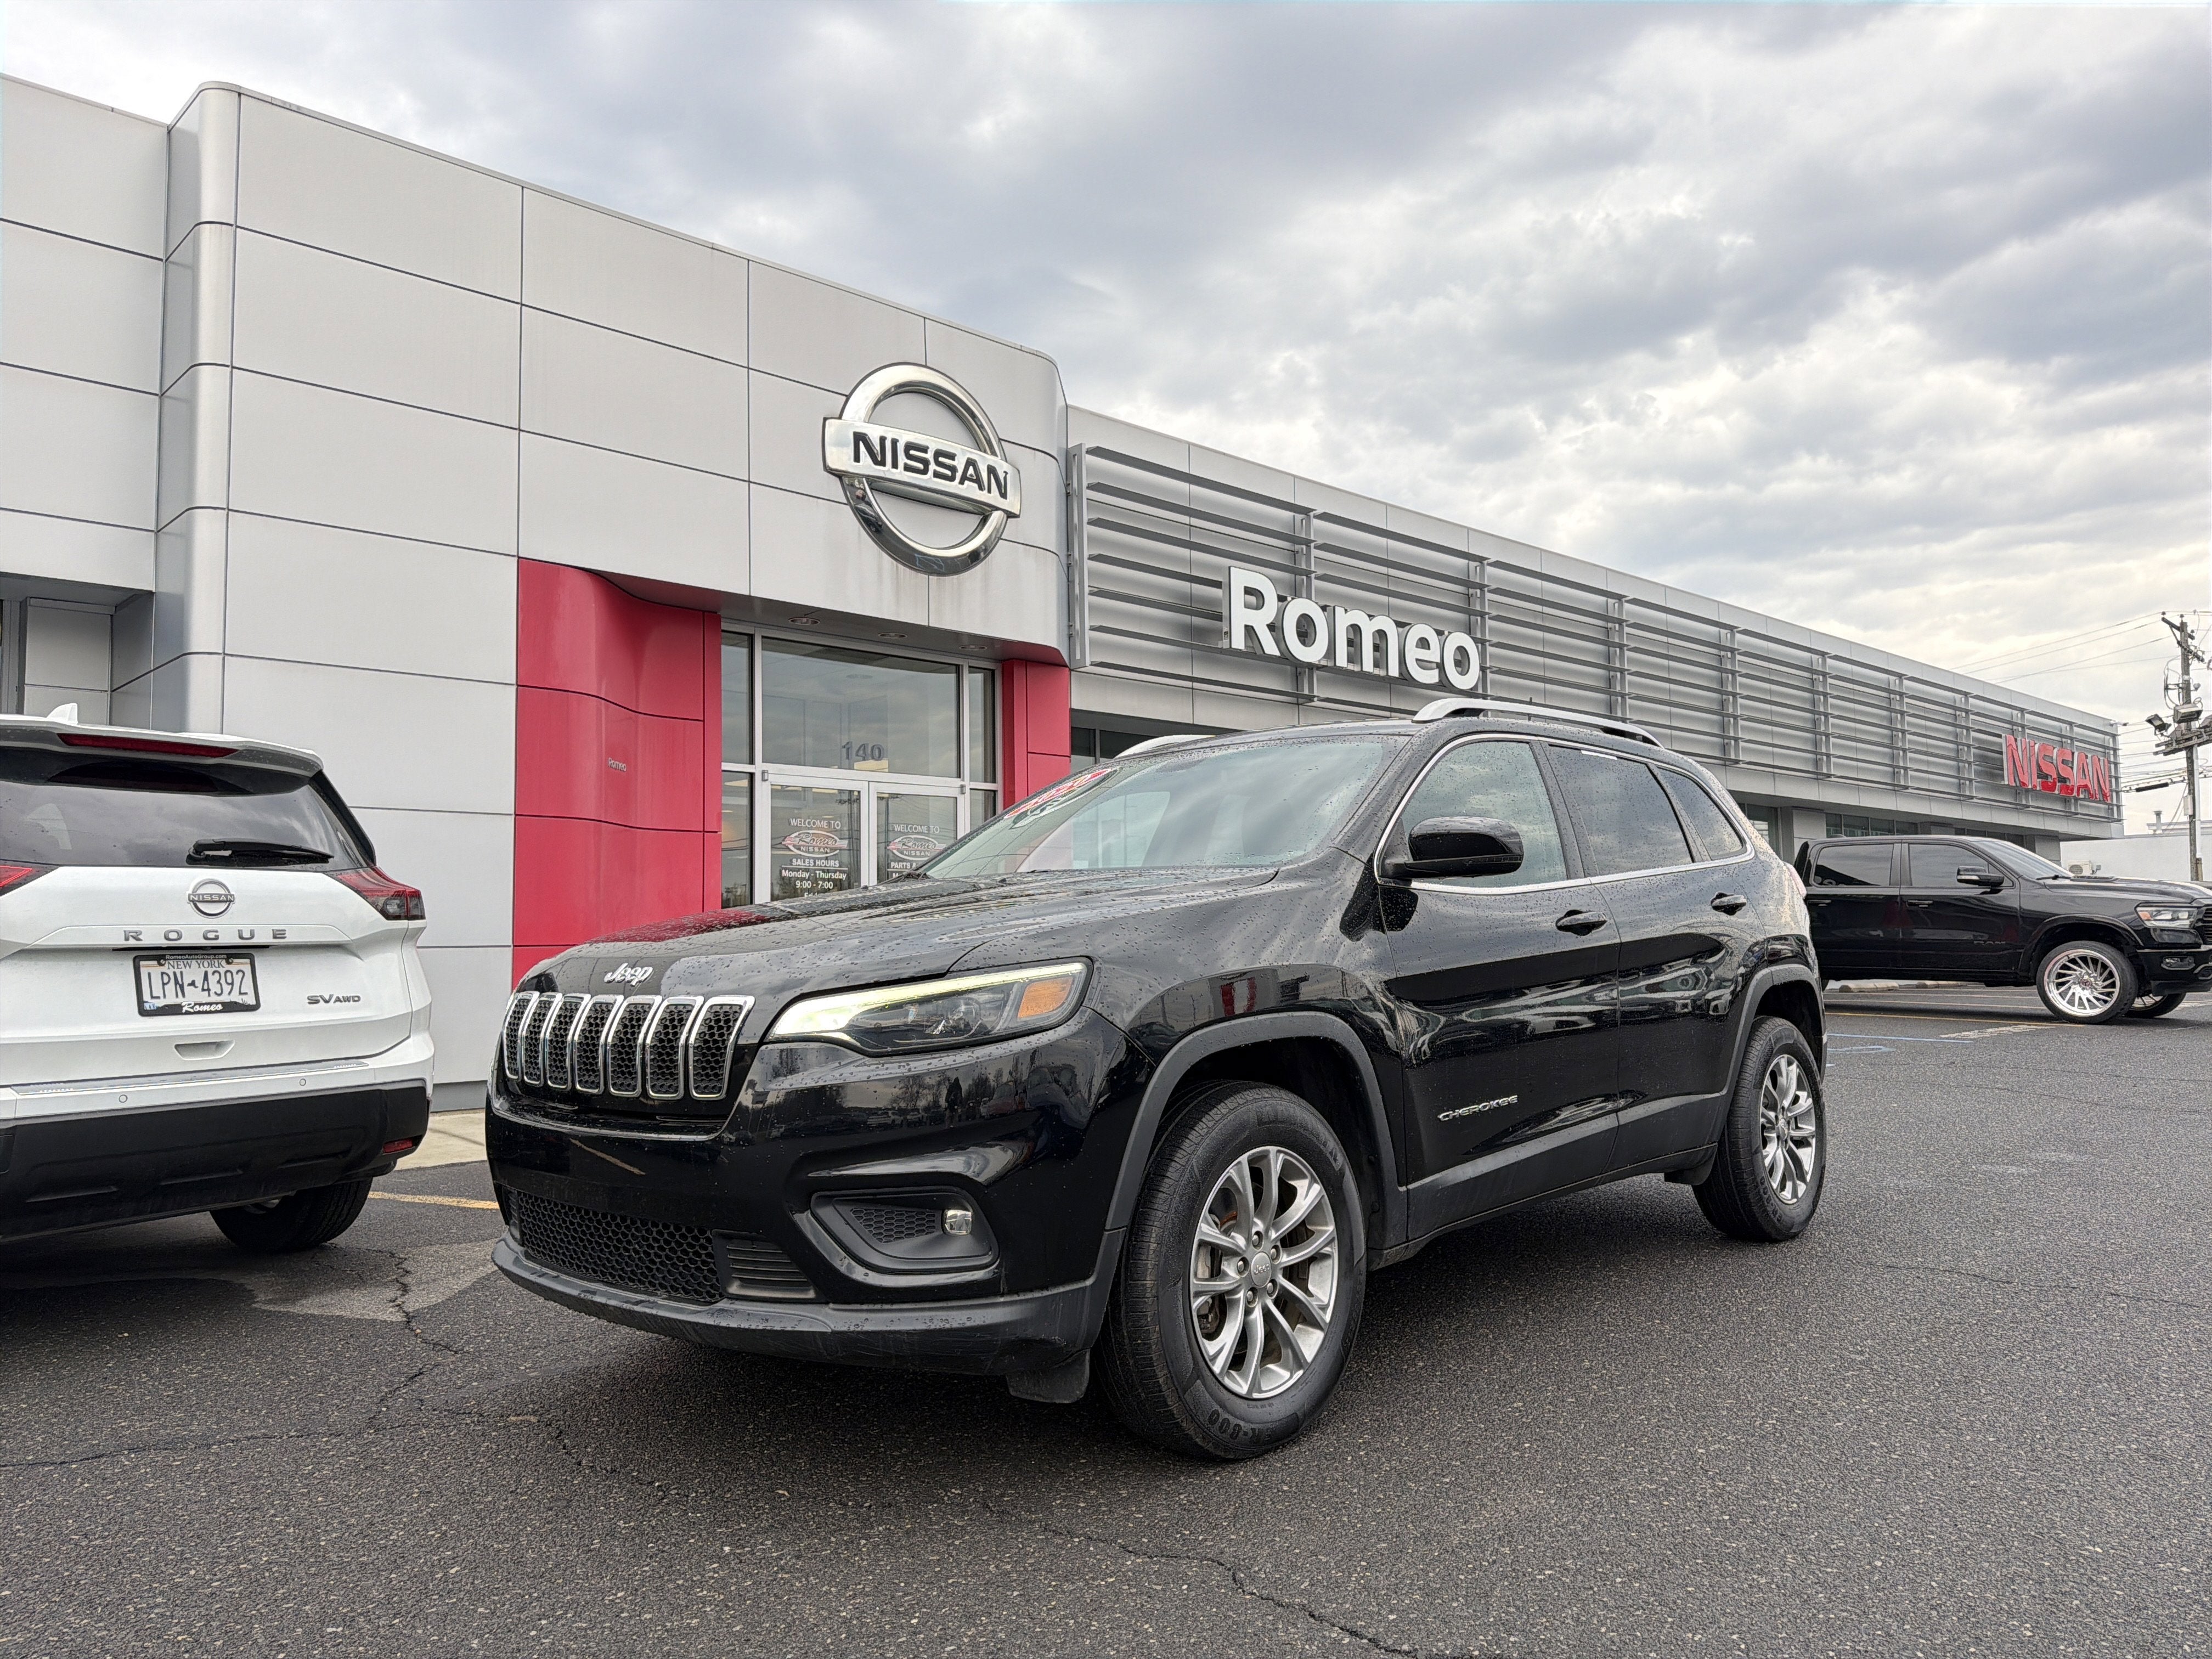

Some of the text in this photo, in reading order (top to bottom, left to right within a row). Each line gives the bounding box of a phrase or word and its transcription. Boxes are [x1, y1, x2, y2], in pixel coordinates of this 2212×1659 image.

[853, 431, 1008, 501] NISSAN
[1227, 565, 1481, 690] Romeo
[842, 741, 884, 761] 140
[608, 757, 627, 771] Romeo
[2004, 734, 2111, 803] NISSAN
[790, 818, 841, 830] WELCOME TO
[894, 824, 928, 833] WELCOME
[795, 832, 837, 846] Romeo
[900, 837, 936, 850] Romeo
[792, 858, 814, 866] SALES
[782, 870, 810, 879] Monday
[815, 871, 847, 881] Thursday
[123, 928, 287, 941] ROGUE
[167, 960, 225, 969] NEW YORK
[604, 963, 653, 987] Jeep
[181, 1001, 223, 1013] Romeo
[1437, 1094, 1518, 1121] CHEROKEE
